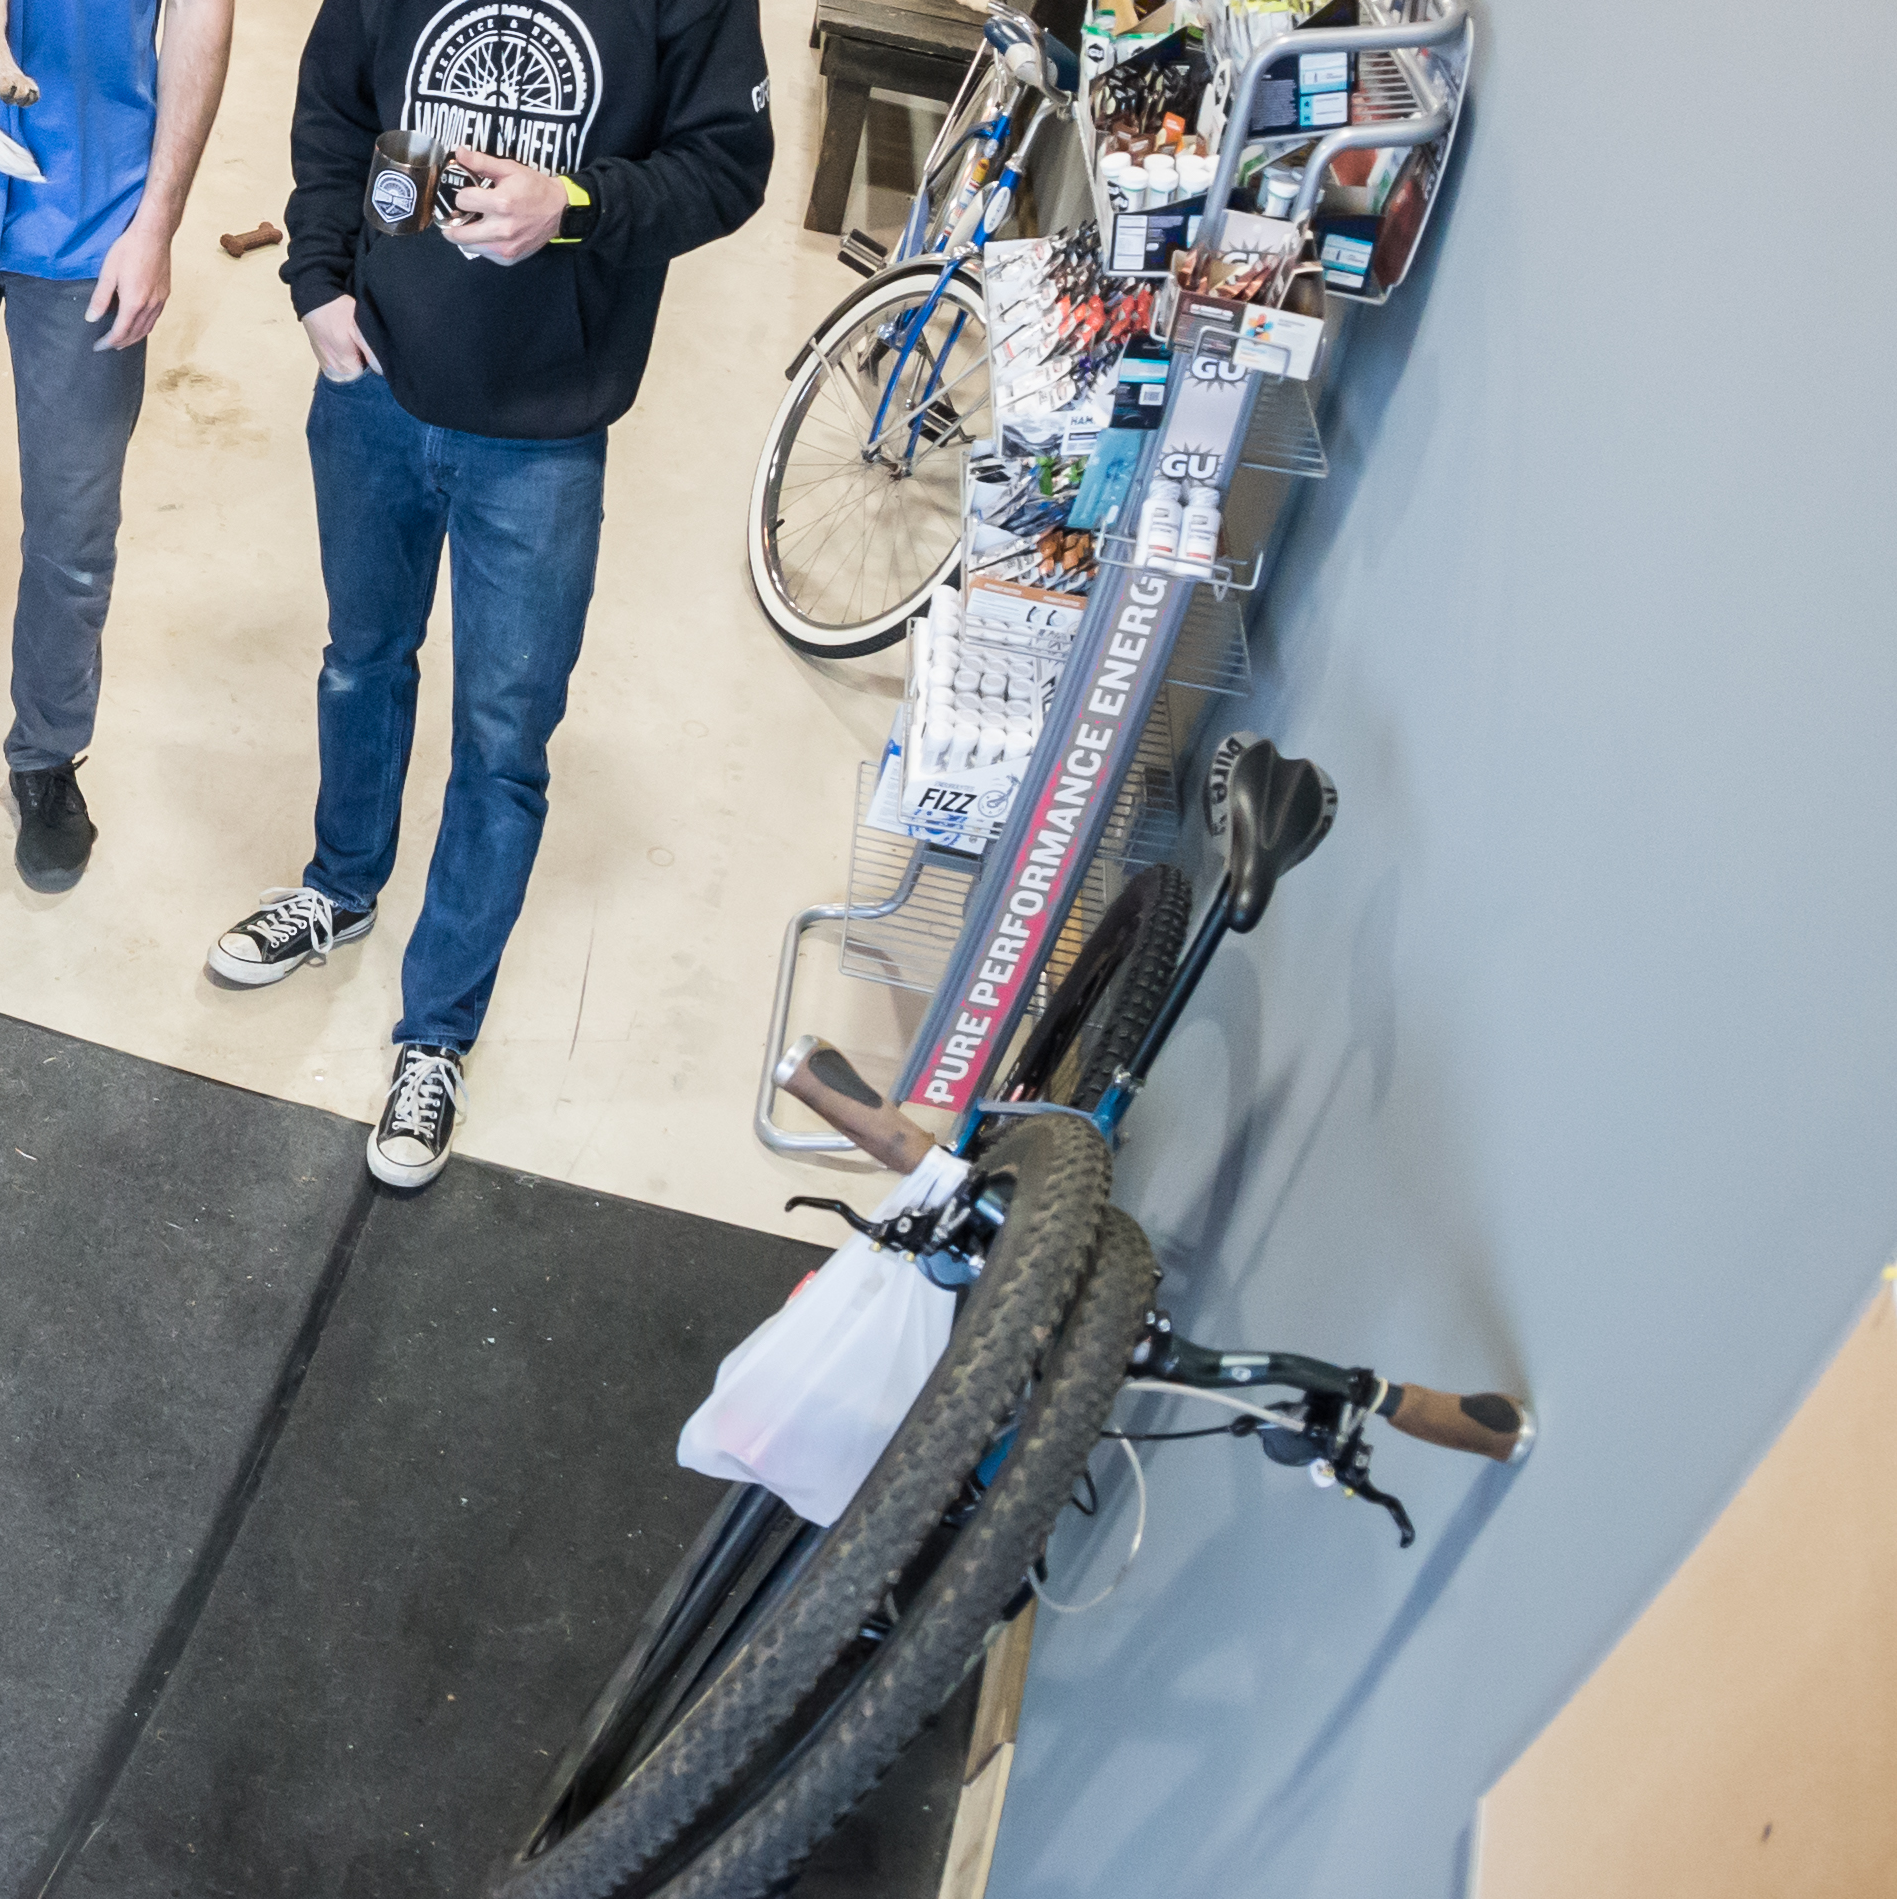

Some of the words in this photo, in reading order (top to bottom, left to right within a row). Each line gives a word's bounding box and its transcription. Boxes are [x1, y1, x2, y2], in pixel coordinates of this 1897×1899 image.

[435, 18, 494, 80] SERVICE
[510, 19, 519, 29] &
[531, 26, 572, 94] REPAIR
[415, 101, 492, 153] WOODEN
[497, 115, 577, 176] WHEELS
[1191, 356, 1246, 381] GU
[1161, 453, 1216, 479] GU
[917, 787, 978, 815] FIZZ
[925, 1006, 991, 1104] PURE
[969, 725, 1113, 1009] PERFORMANCE
[1088, 574, 1168, 718] ENERG
